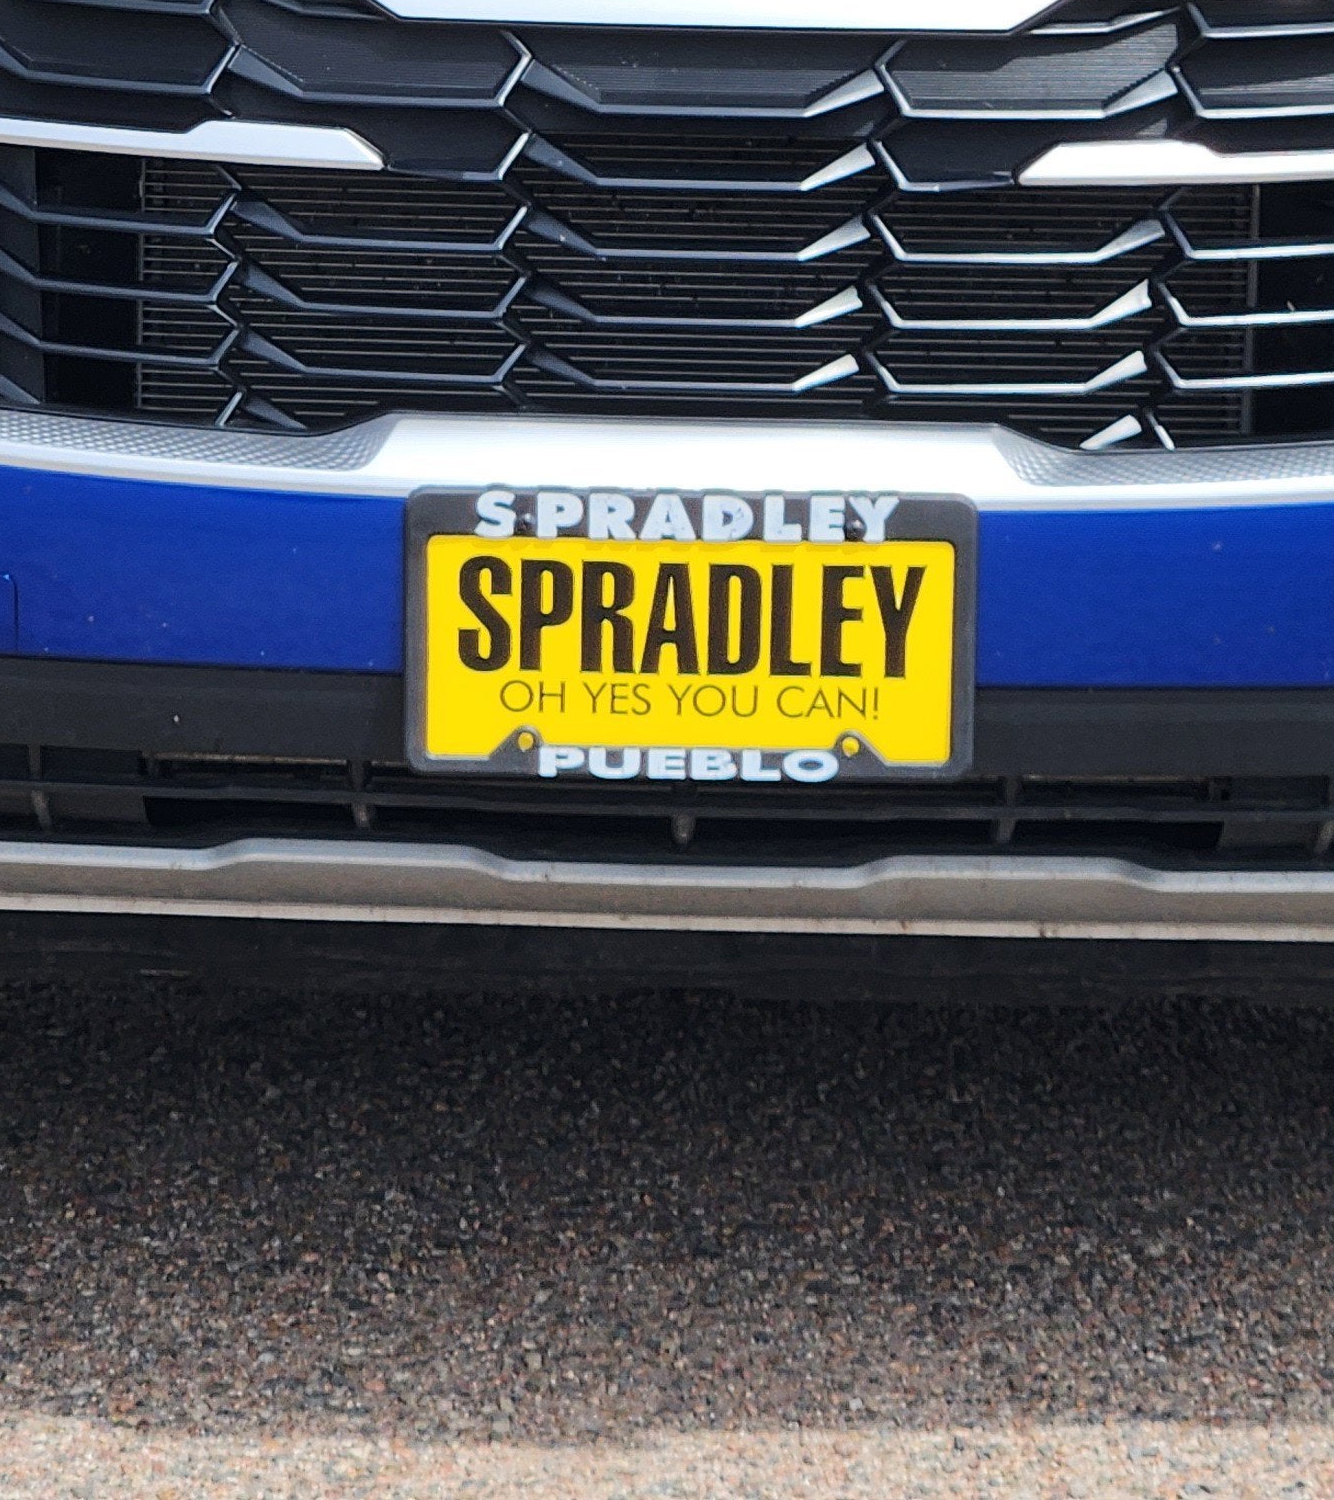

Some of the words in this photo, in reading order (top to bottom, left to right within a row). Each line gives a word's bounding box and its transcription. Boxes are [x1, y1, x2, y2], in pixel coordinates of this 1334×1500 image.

[474, 489, 901, 543] SPRADLEY
[457, 555, 927, 679] SPRADLEY
[499, 679, 567, 713] OH
[582, 682, 652, 716] YES
[667, 684, 759, 719] YOU
[776, 685, 880, 720] CAN!
[537, 746, 840, 783] PUEBLO
